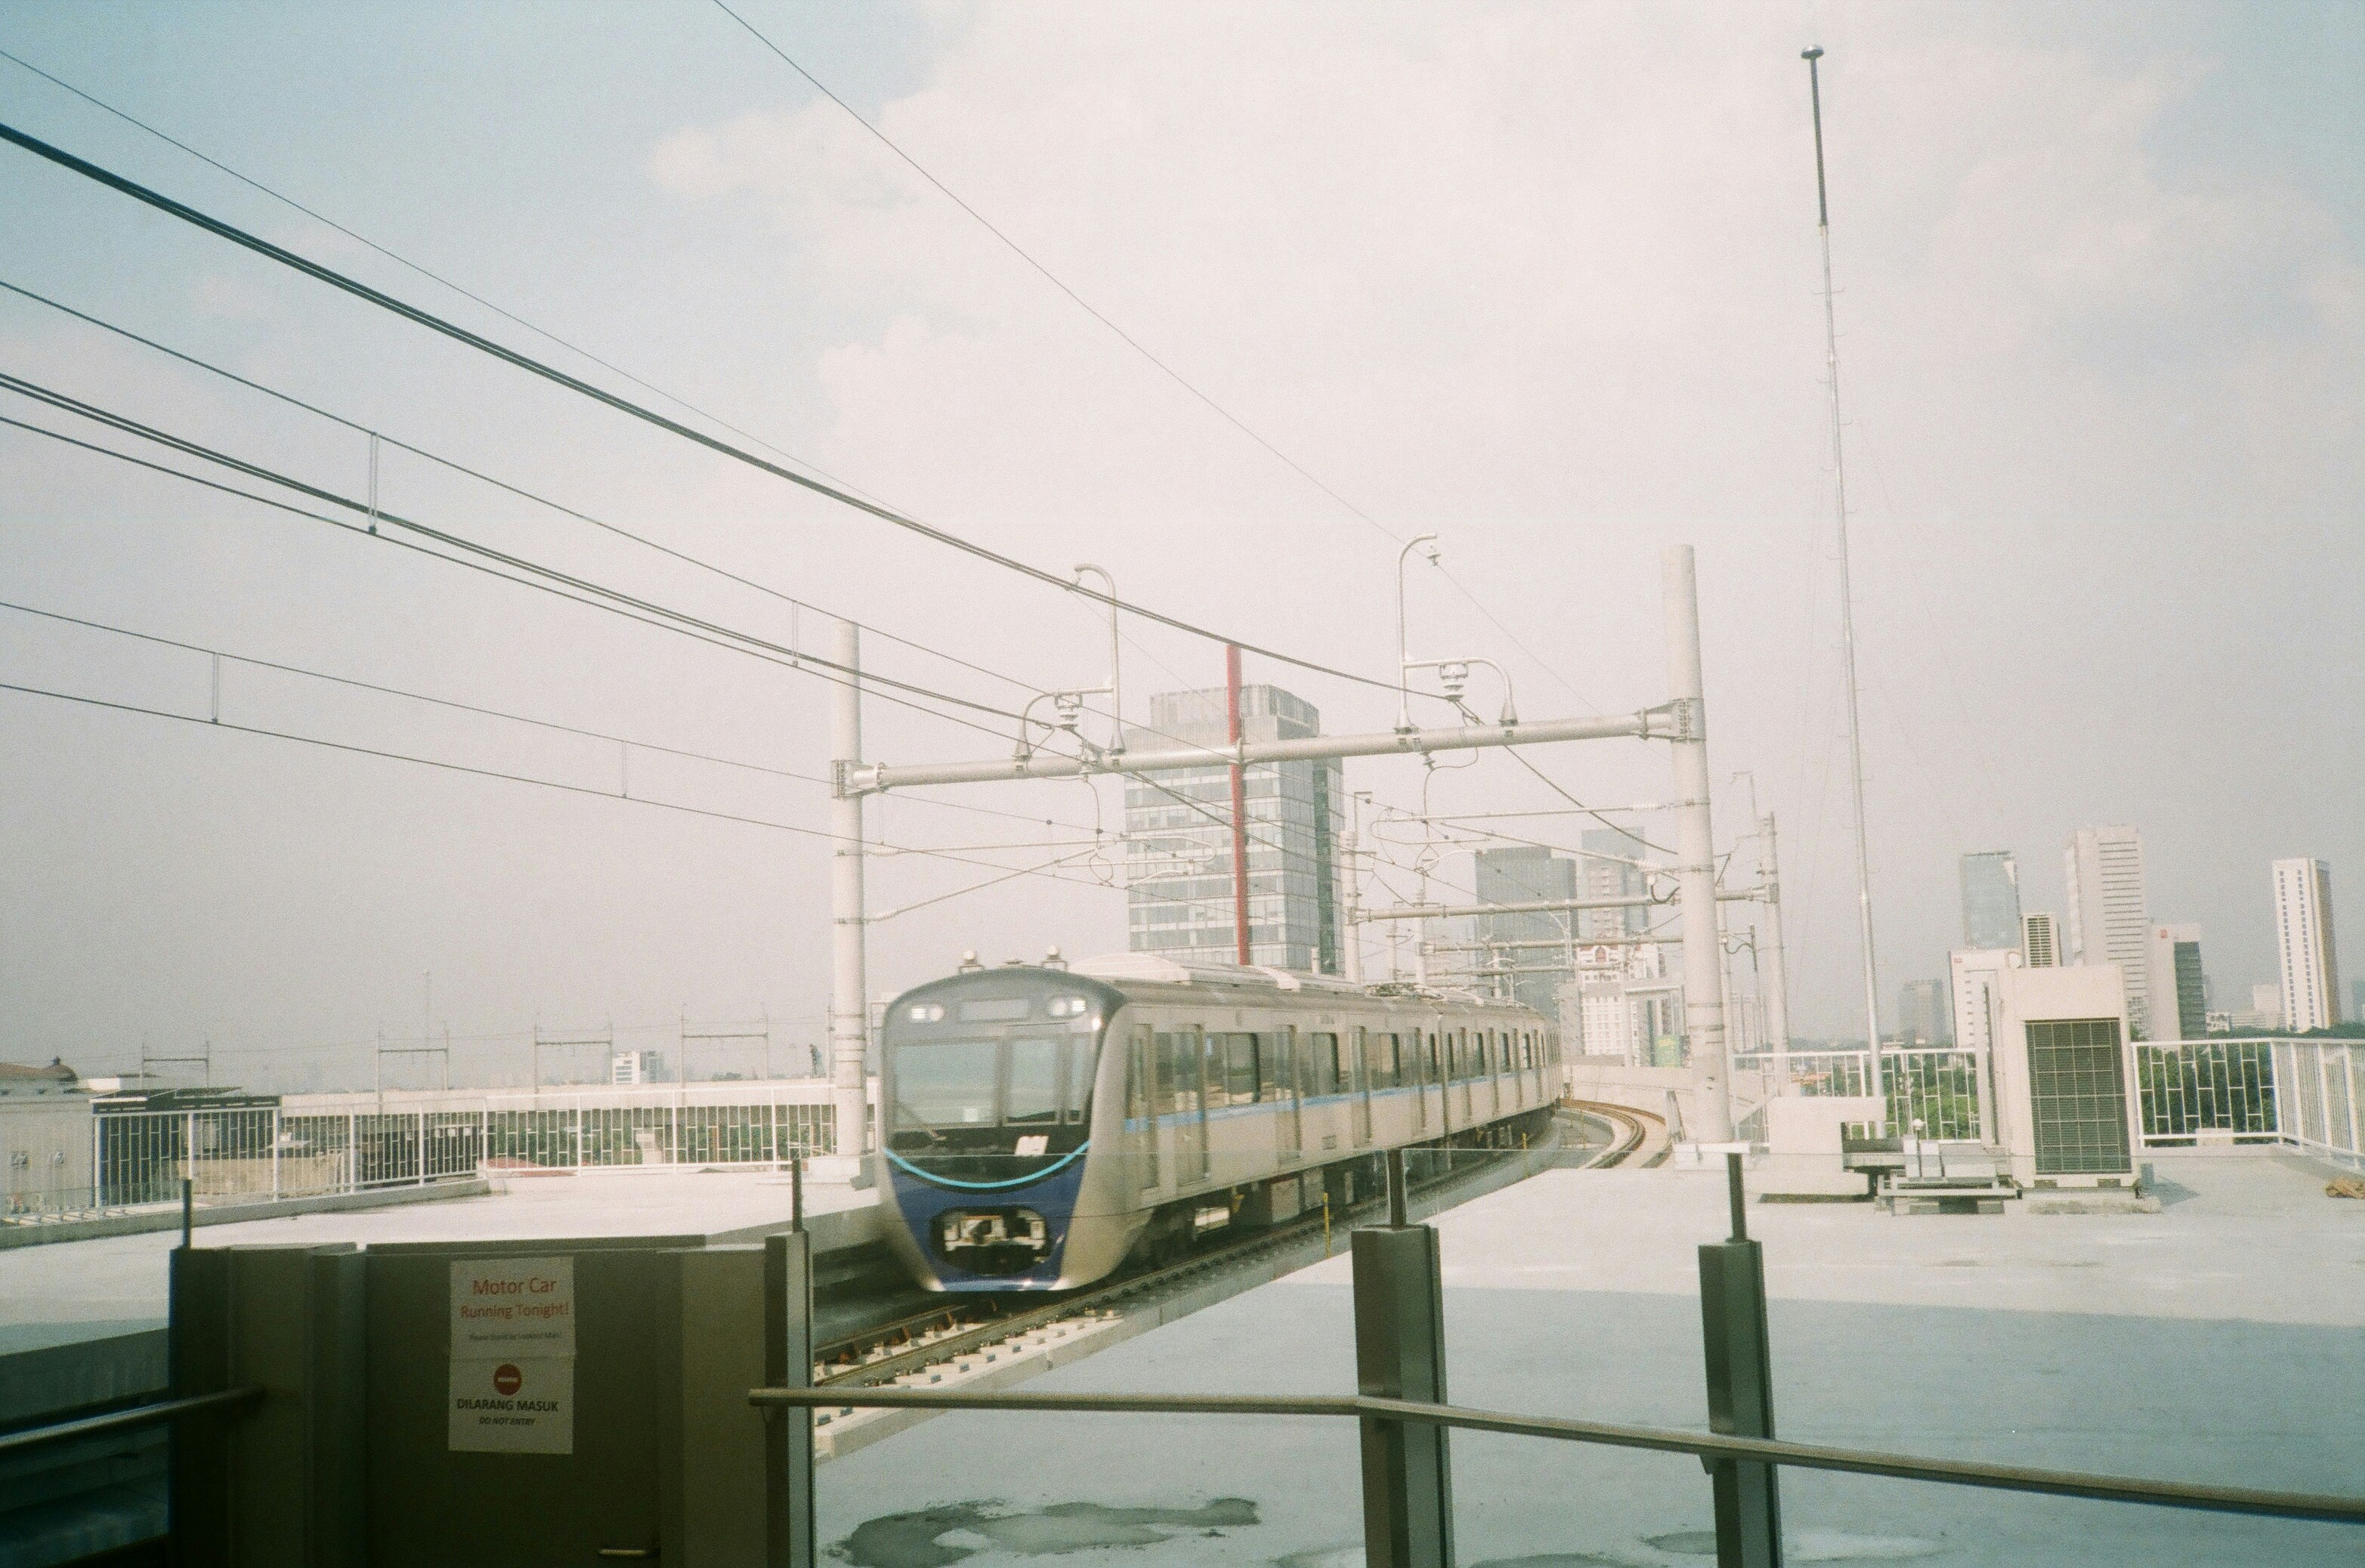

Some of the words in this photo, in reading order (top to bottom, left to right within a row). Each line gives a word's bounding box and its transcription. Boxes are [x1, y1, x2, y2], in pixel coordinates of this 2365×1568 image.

[472, 1279, 524, 1295] Motor
[529, 1277, 557, 1293] Car
[461, 1305, 512, 1319] Running
[516, 1303, 569, 1319] Tonight!
[457, 1399, 514, 1411] DILARANG
[517, 1401, 558, 1412] MASUK
[510, 1418, 536, 1426] ENTRY
